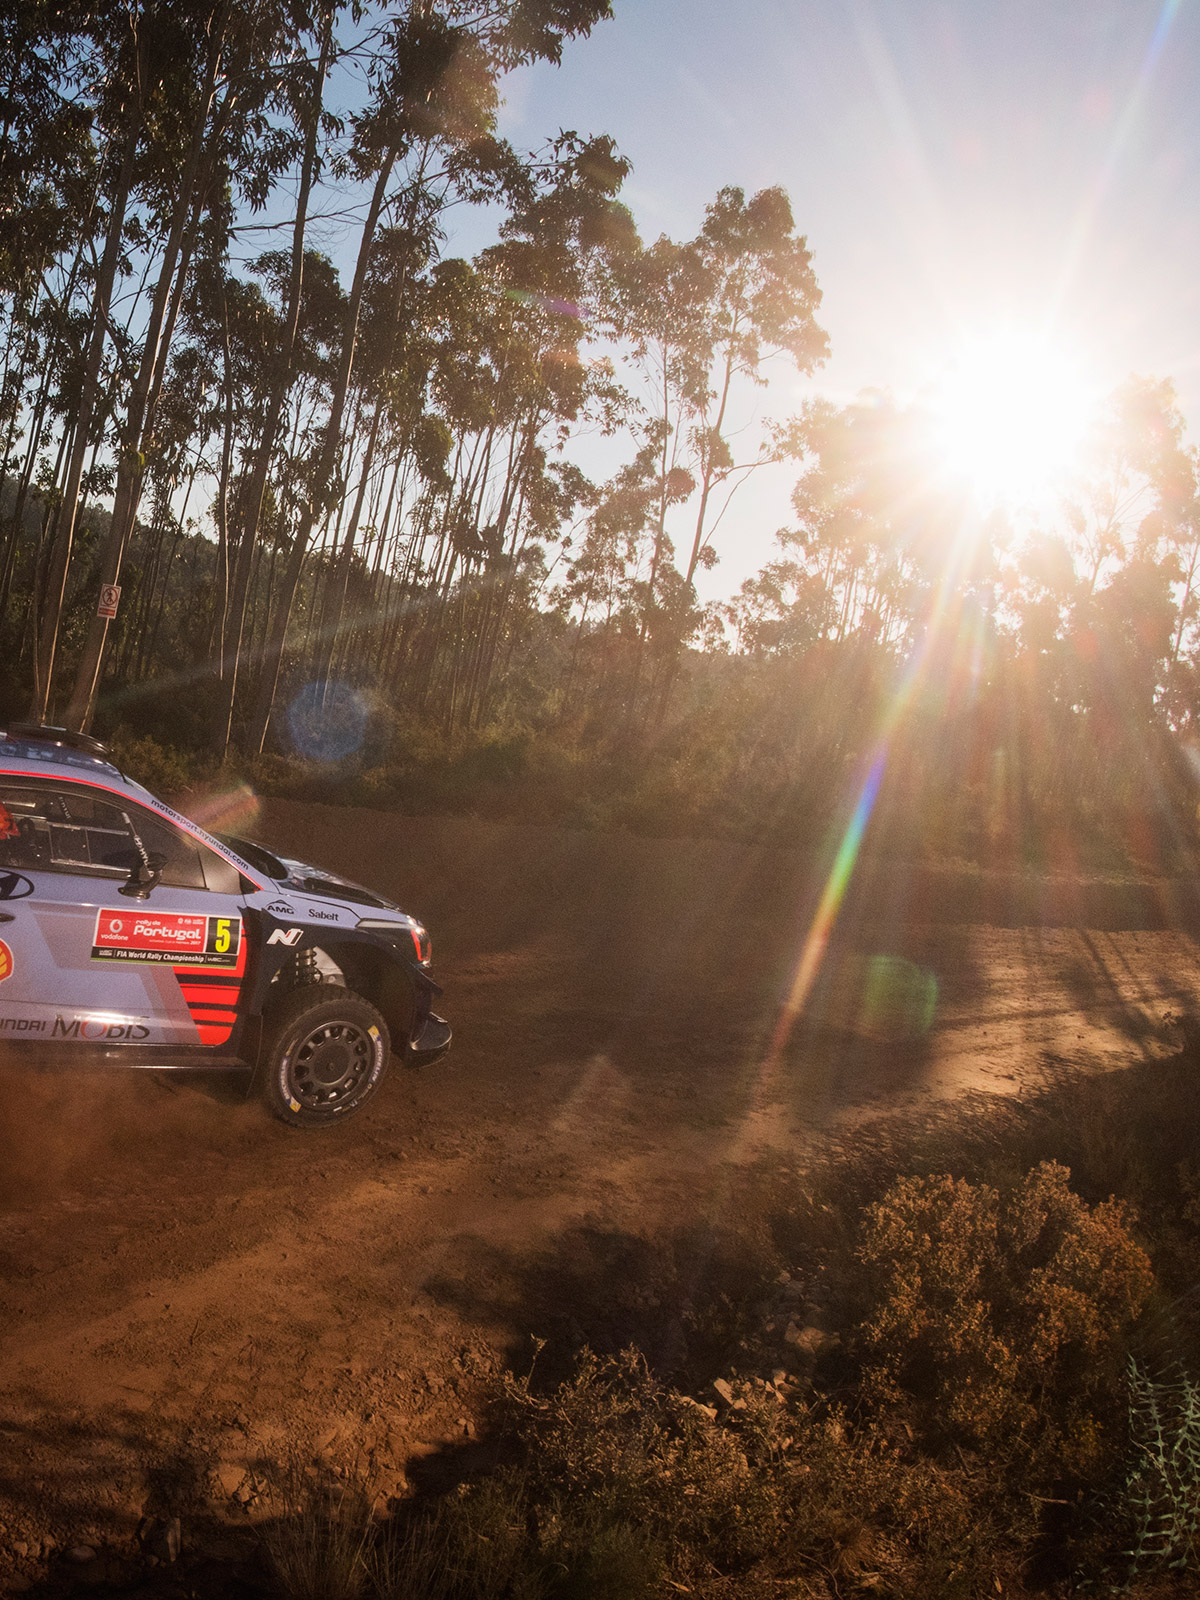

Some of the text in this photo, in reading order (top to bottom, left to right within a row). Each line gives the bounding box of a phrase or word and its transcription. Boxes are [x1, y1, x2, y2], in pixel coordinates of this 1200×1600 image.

[151, 799, 250, 870] motorsport.hyundai.com
[267, 905, 295, 915] AMG
[308, 908, 339, 921] Sabelt
[101, 933, 129, 941] vodafone
[133, 925, 202, 941] Portugal
[215, 919, 231, 953] 5
[128, 952, 146, 960] World
[147, 952, 162, 961] Rally
[163, 953, 204, 963] Championship
[51, 1014, 151, 1040] MOBIS
